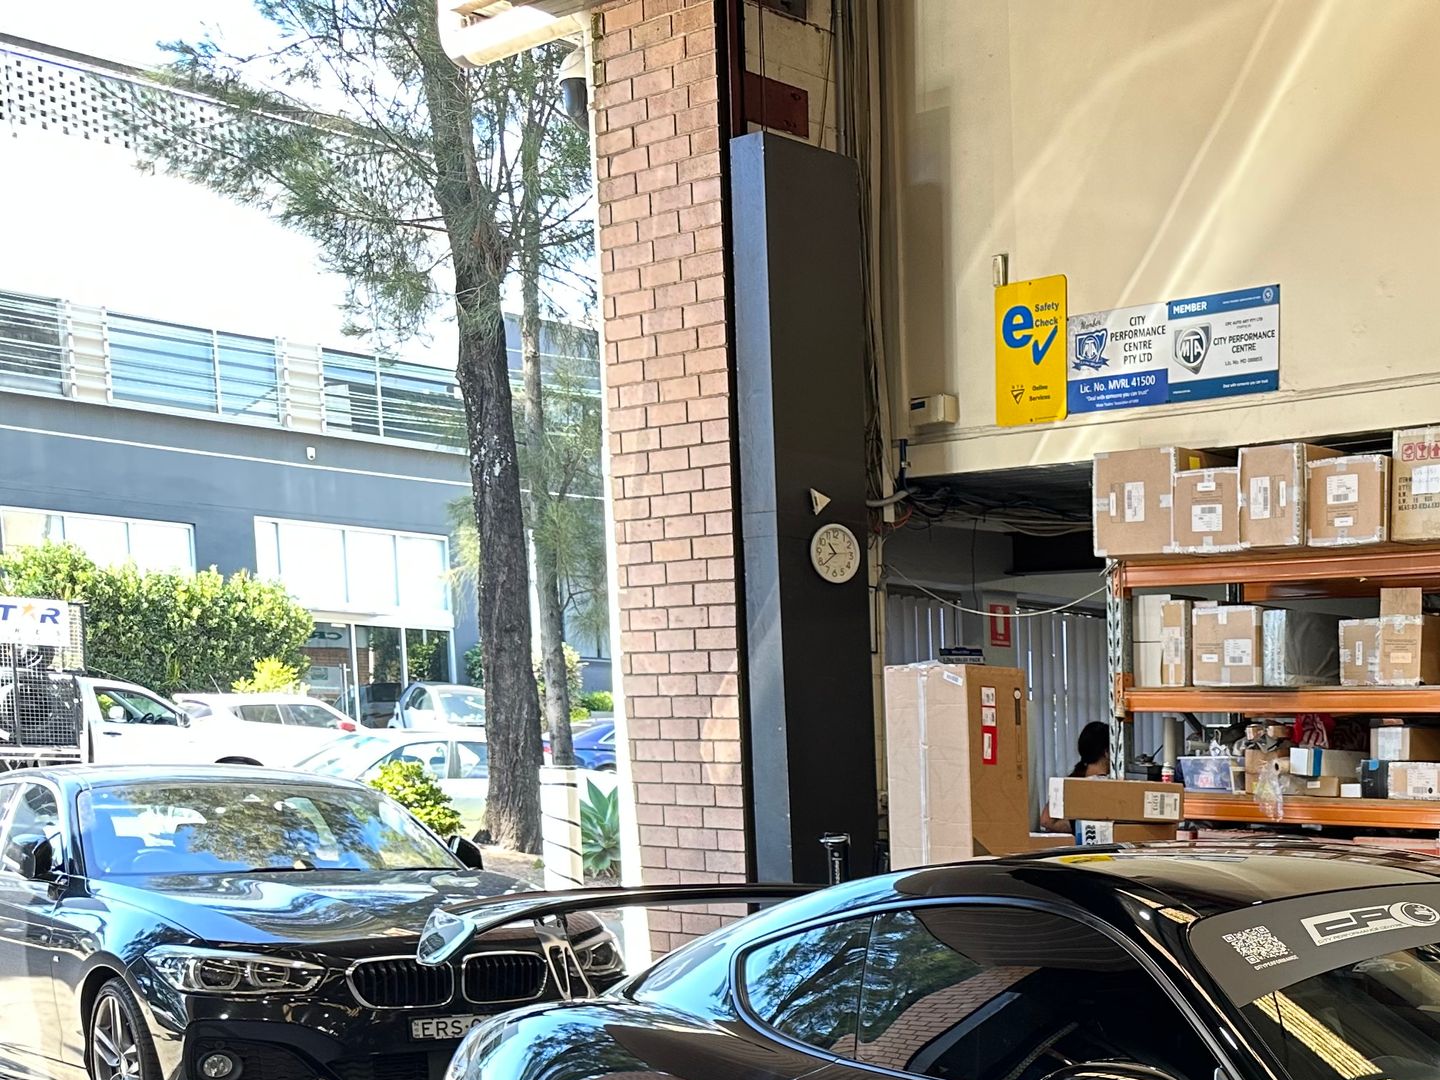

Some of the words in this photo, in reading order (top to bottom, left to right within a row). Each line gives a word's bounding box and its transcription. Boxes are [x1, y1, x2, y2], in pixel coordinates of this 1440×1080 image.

[1034, 302, 1060, 313] Safety
[1173, 301, 1208, 315] MEMBER
[1034, 317, 1058, 328] Check
[1129, 315, 1146, 327] CITY
[1002, 305, 1034, 349] e
[1110, 325, 1166, 342] PERFORMANCE
[1213, 336, 1227, 346] CITY
[1228, 329, 1276, 344] PERFORMANCE
[1124, 340, 1152, 352] CENTRE
[1180, 335, 1204, 363] MTA
[1232, 343, 1257, 354] CENTRE
[1124, 355, 1137, 365] PTY
[1140, 353, 1152, 362] LTD
[1080, 384, 1092, 394] Lic.
[1094, 382, 1107, 392] No.
[1108, 379, 1130, 391] MVRL
[1131, 375, 1156, 387] 41500
[832, 530, 840, 540] 12
[846, 541, 851, 549] 2
[849, 551, 854, 560] 3
[825, 565, 830, 575] 7
[846, 561, 851, 569] 4
[832, 569, 838, 577] 6
[840, 568, 845, 576] 5
